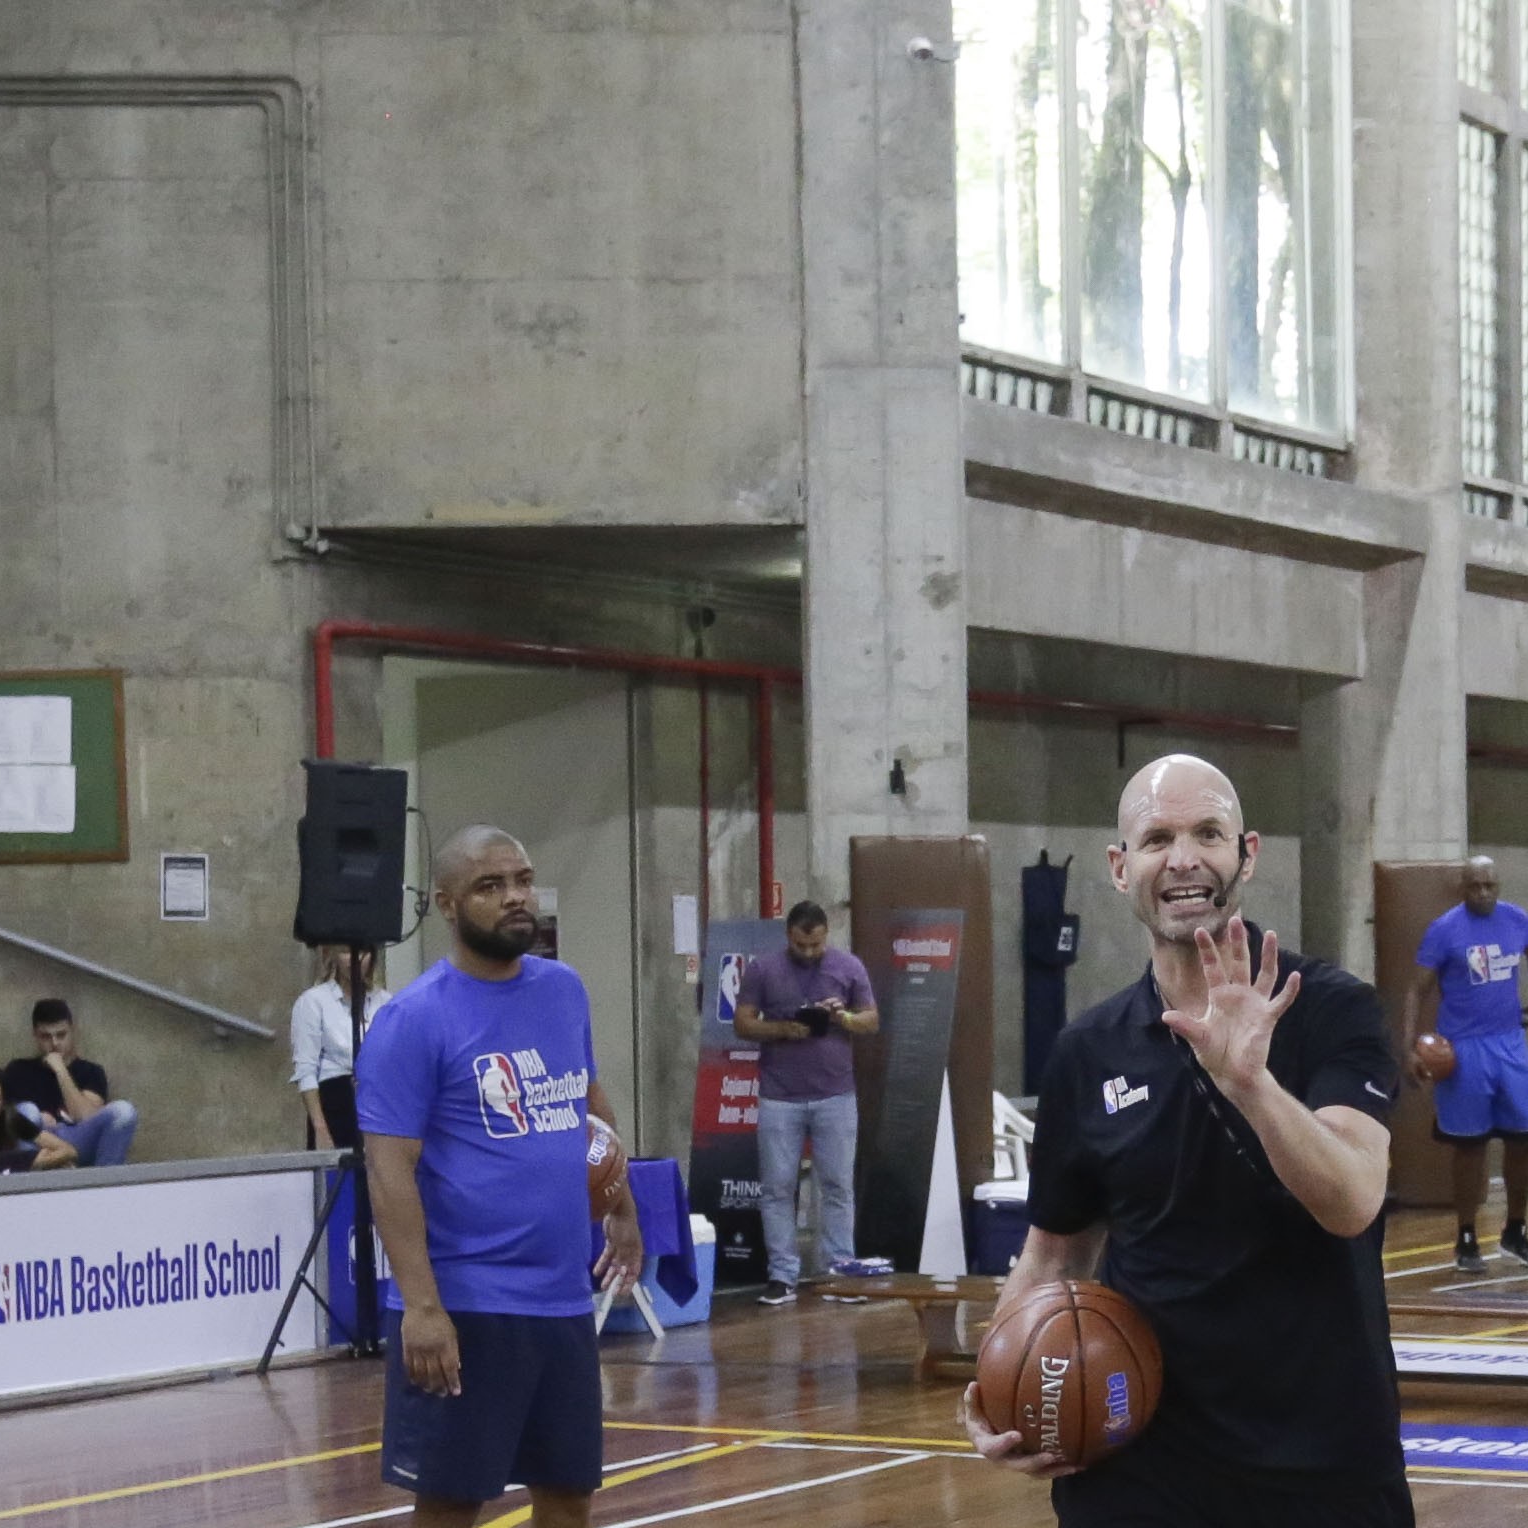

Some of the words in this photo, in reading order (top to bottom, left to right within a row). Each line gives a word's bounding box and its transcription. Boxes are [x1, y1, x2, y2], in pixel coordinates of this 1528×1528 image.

[511, 1048, 546, 1079] NBA
[528, 1101, 580, 1133] School
[721, 1180, 763, 1196] THINK
[14, 1257, 66, 1322] NBA
[70, 1246, 199, 1315] Basketball
[203, 1234, 282, 1299] School
